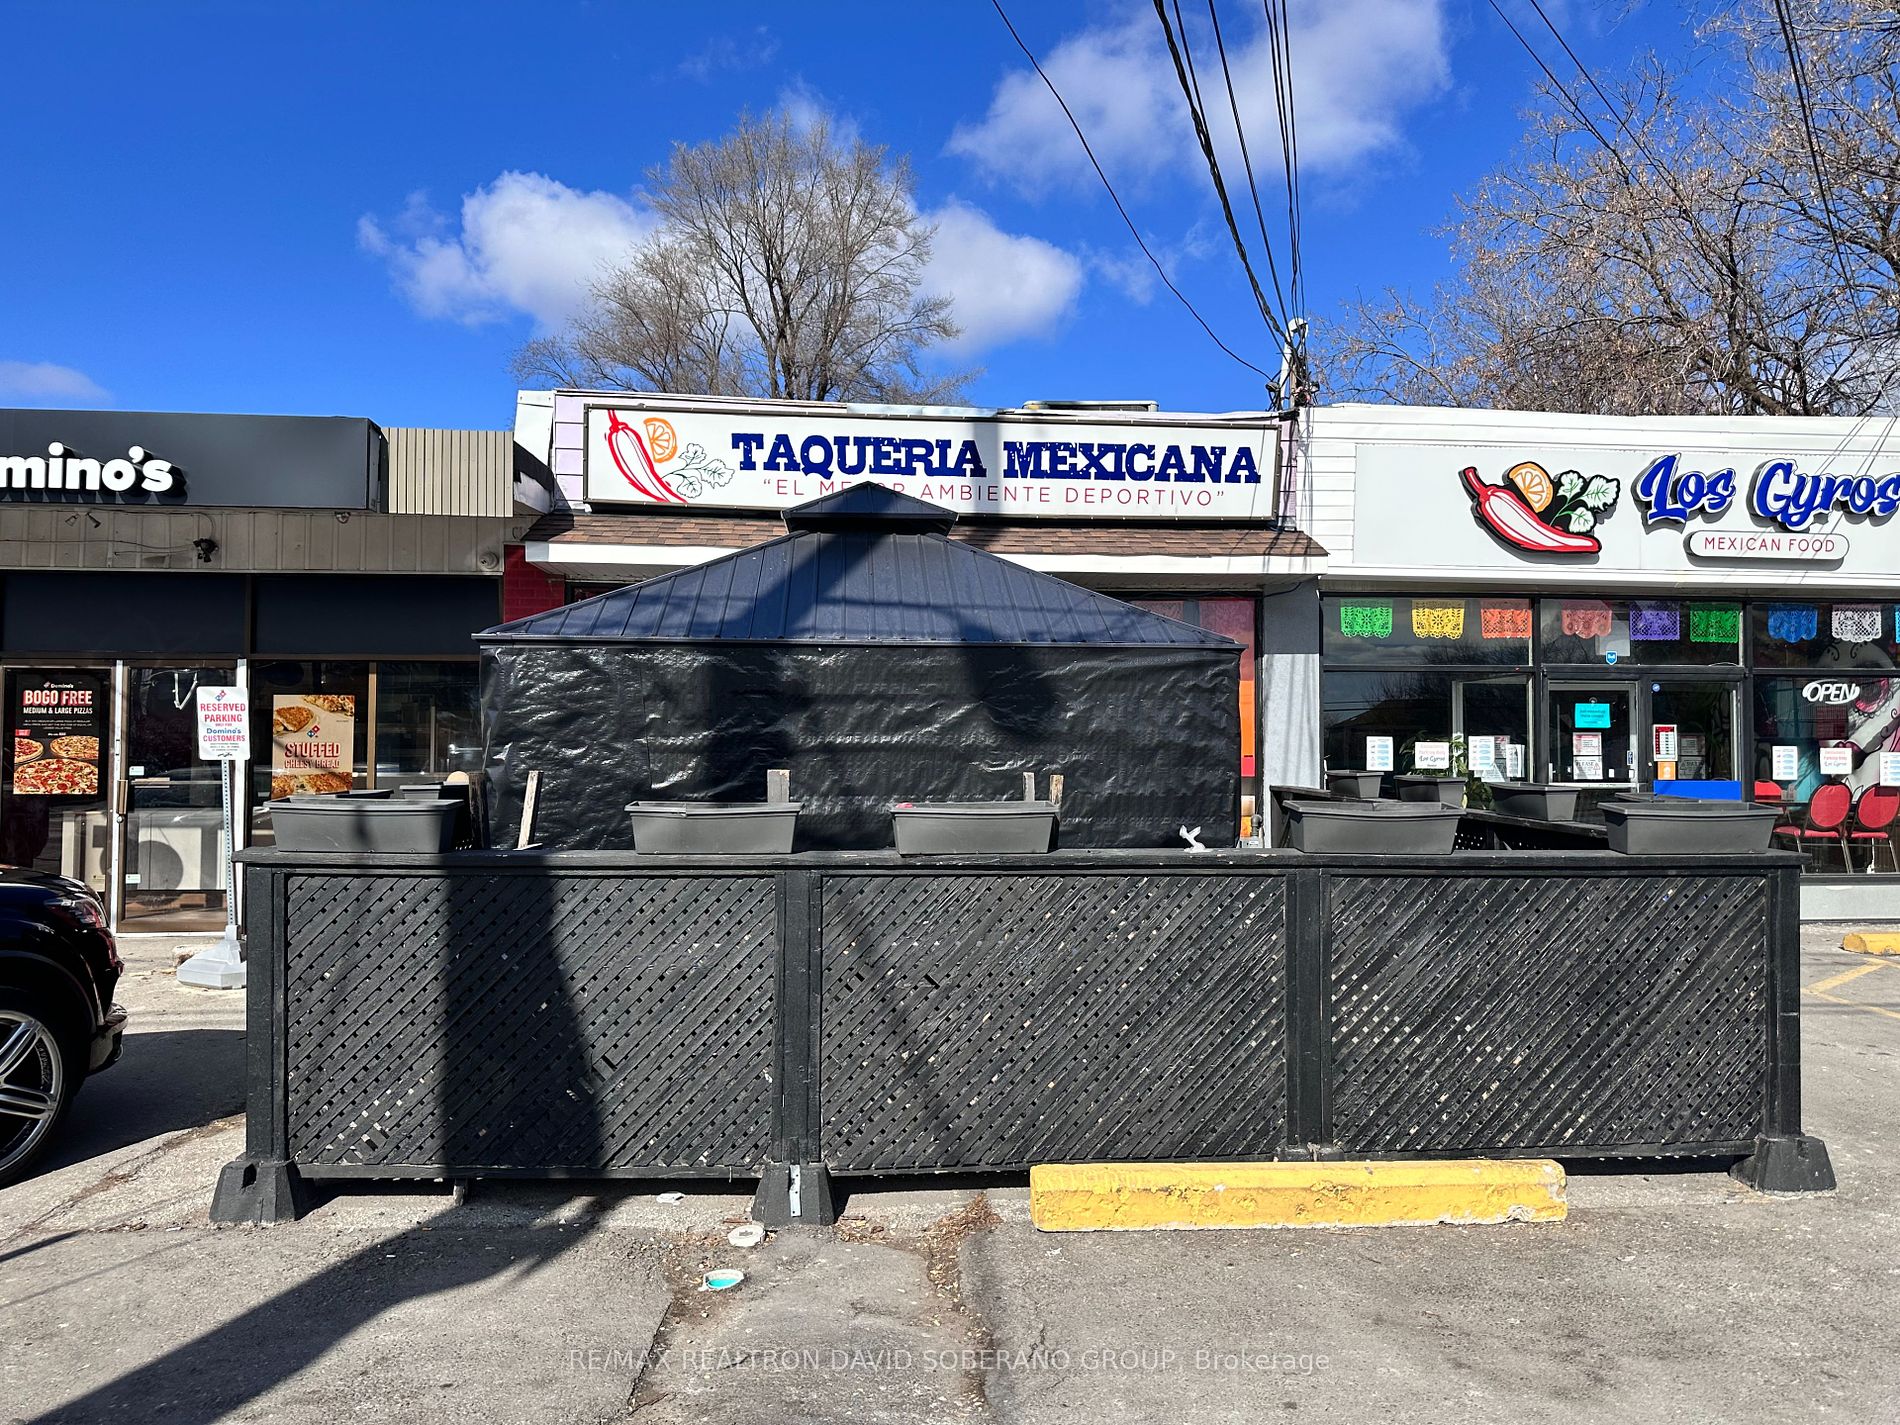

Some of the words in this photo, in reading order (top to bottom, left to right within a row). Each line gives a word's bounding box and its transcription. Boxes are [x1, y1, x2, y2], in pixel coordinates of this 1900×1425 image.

[731, 433, 987, 480] TAQUERIA
[1003, 441, 1261, 483] MEXICANA
[920, 484, 1050, 502] AMBIENTE
[1065, 487, 1224, 506] DEPORTIVO”
[1640, 453, 1736, 521] Los
[1755, 460, 1900, 528] Gyros
[1704, 537, 1780, 552] MEXICAN
[1789, 539, 1835, 553] FOOD
[23, 690, 59, 706] BOGO
[61, 690, 93, 706] FREE
[1806, 682, 1857, 702] OPEN
[200, 703, 246, 712] RESERVED
[204, 714, 243, 722] PARKING
[285, 742, 341, 758] STUFFED
[315, 760, 340, 769] BREAD
